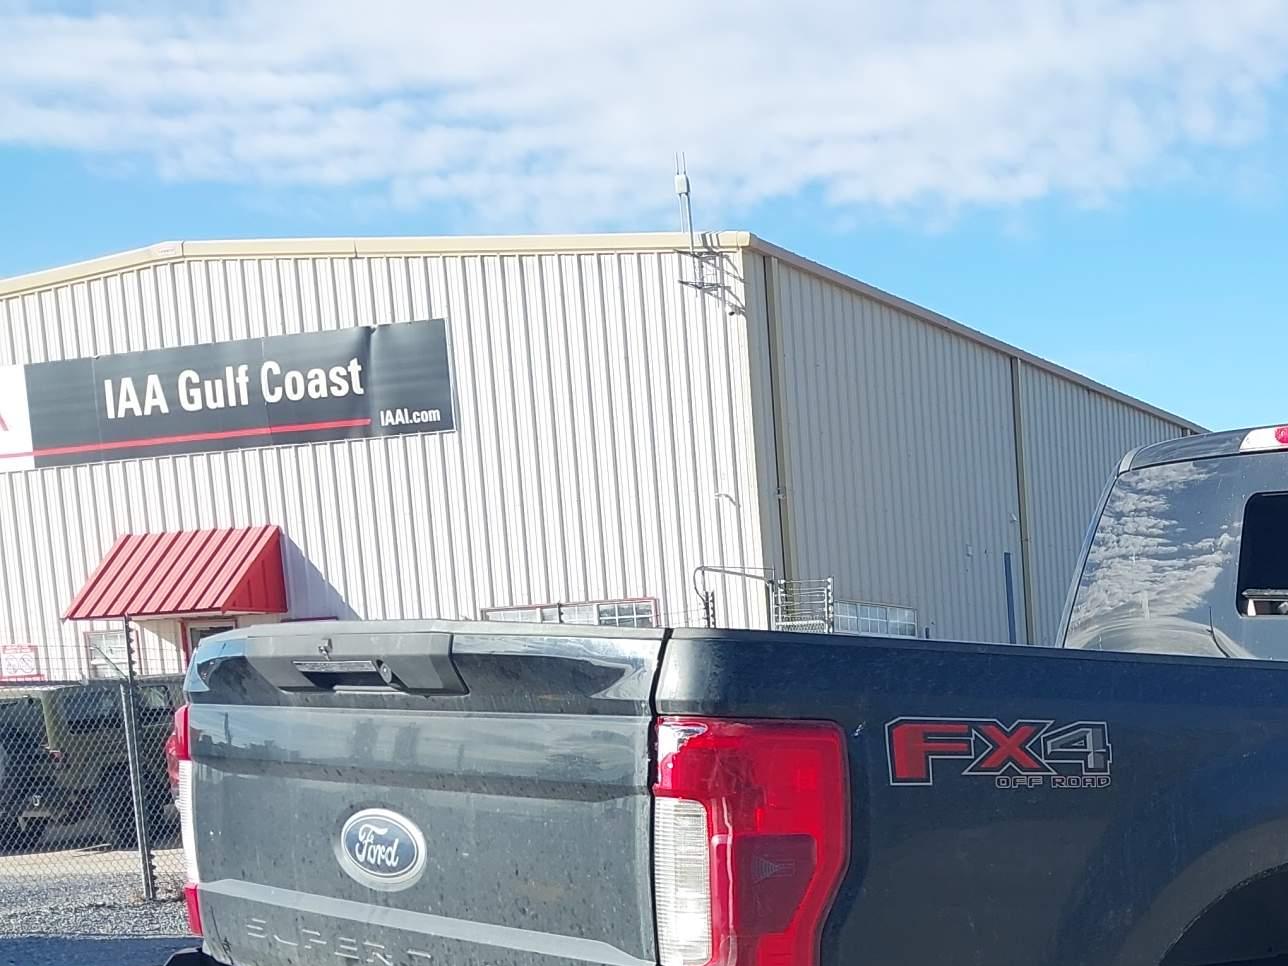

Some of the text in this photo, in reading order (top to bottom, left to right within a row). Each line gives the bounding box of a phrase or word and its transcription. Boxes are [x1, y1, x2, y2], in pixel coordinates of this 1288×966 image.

[104, 357, 365, 419] IAA Gulf Coast
[380, 408, 441, 426] IAAI.com
[885, 717, 1112, 786] FX4
[995, 776, 1111, 789] OFF ROAD
[355, 823, 399, 867] Ford
[246, 917, 394, 966] SUPER
